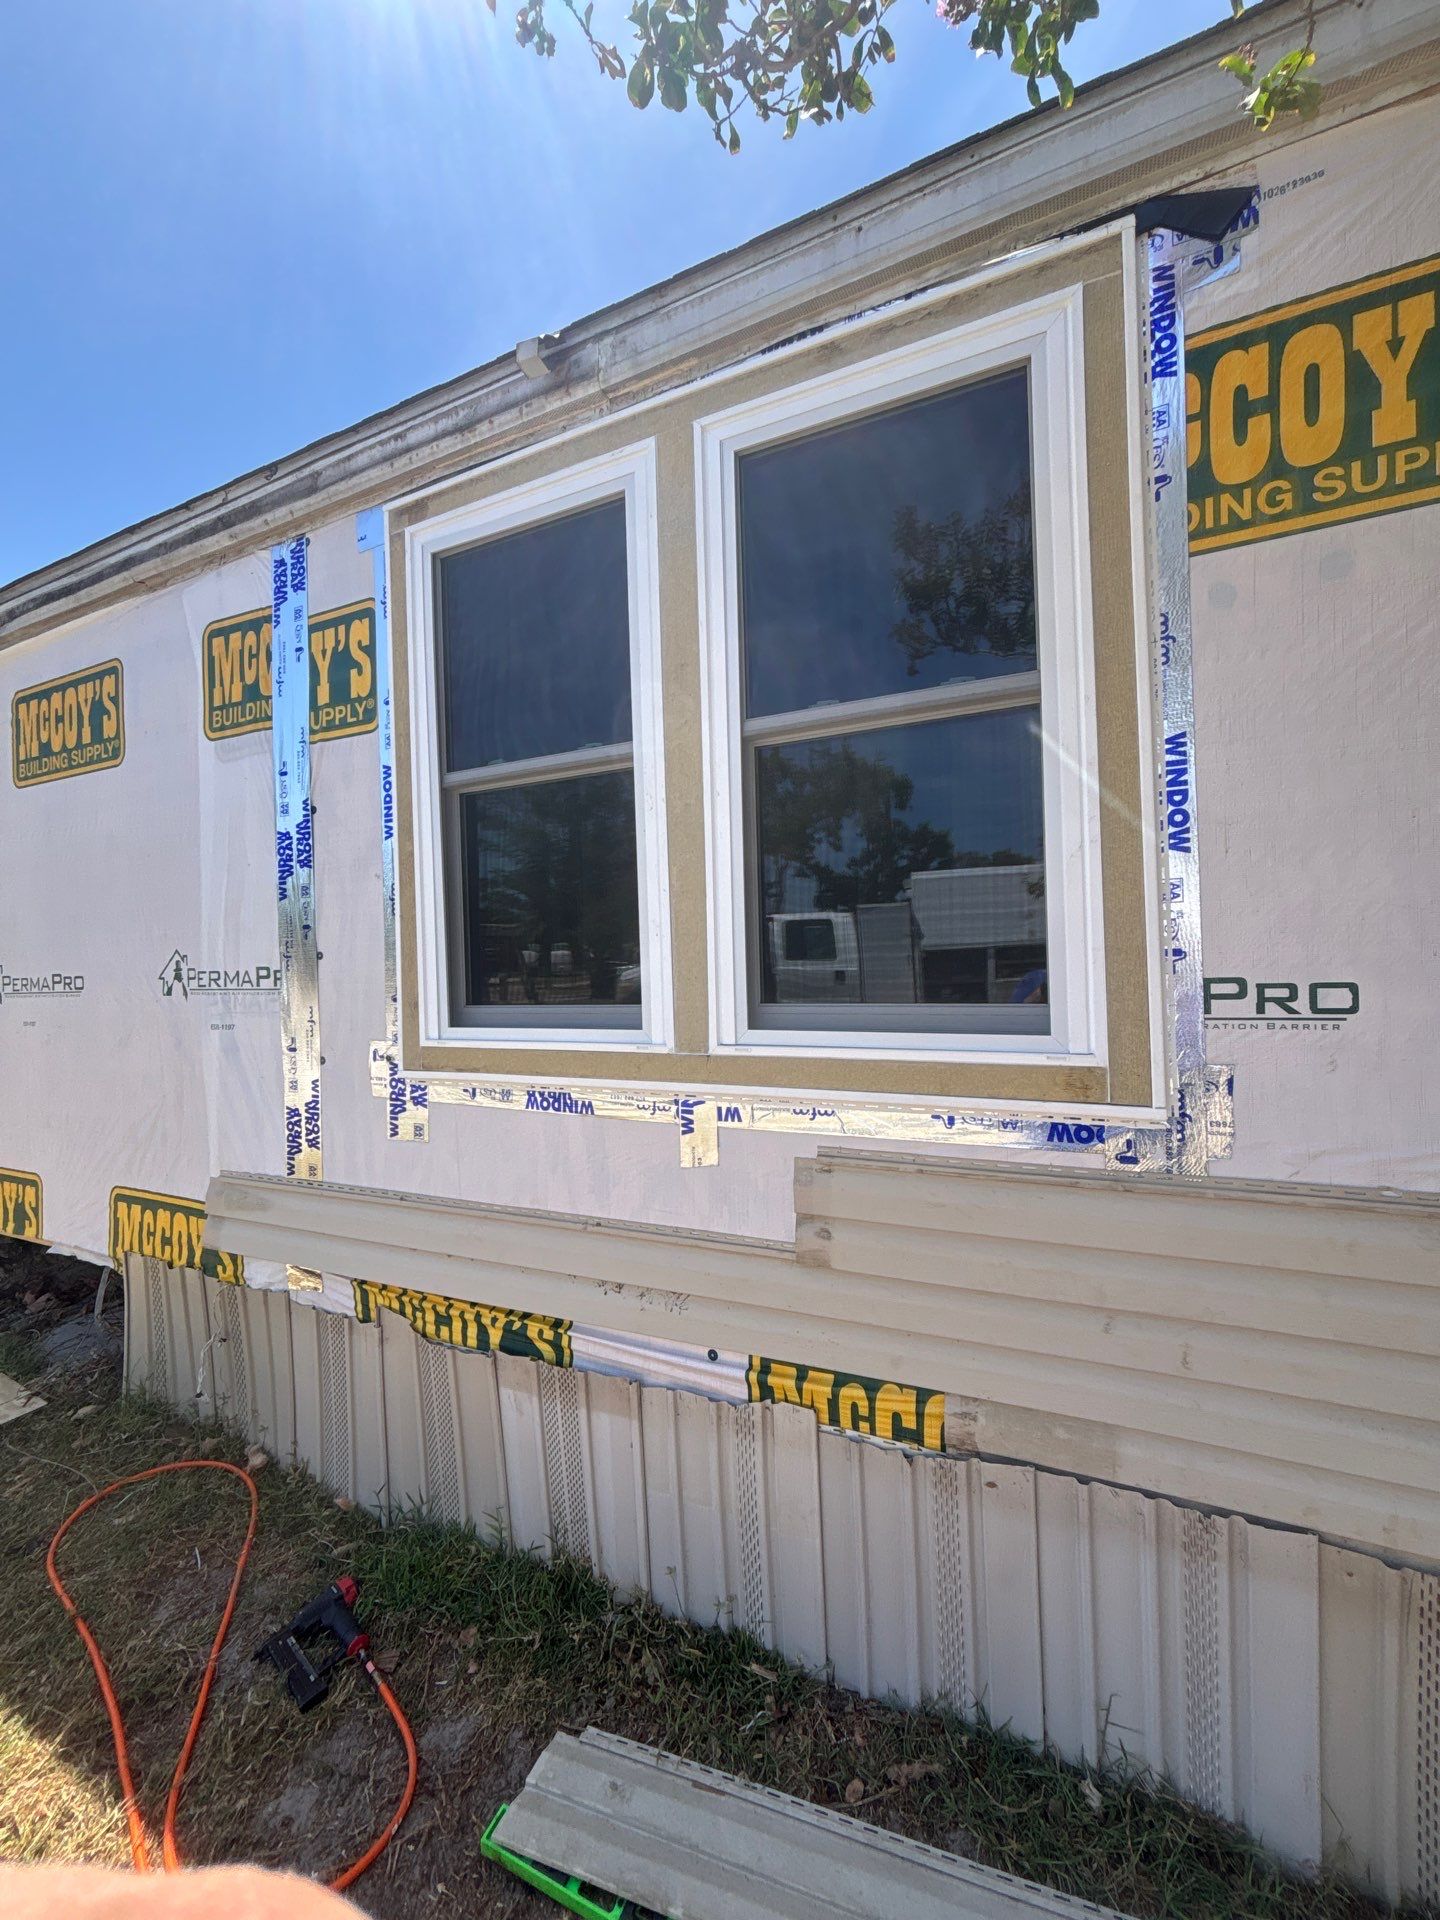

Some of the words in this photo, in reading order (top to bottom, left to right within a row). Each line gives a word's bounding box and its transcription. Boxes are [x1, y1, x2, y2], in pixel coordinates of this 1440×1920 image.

[1150, 263, 1178, 379] WINDOW
[1312, 441, 1440, 502] SUP
[212, 700, 273, 728] BUILDIN
[19, 752, 69, 778] BUILDING
[1163, 730, 1192, 855] WINDOW
[302, 797, 313, 869] WINDOW
[382, 764, 394, 842] WINDOW
[277, 830, 287, 902] WINDOW
[1266, 1022, 1341, 1031] BARRIER
[310, 1078, 321, 1151] WINDOW
[388, 1061, 399, 1138] WINDOW
[525, 1094, 595, 1116] WINDOW
[286, 1105, 296, 1177] WINDOW
